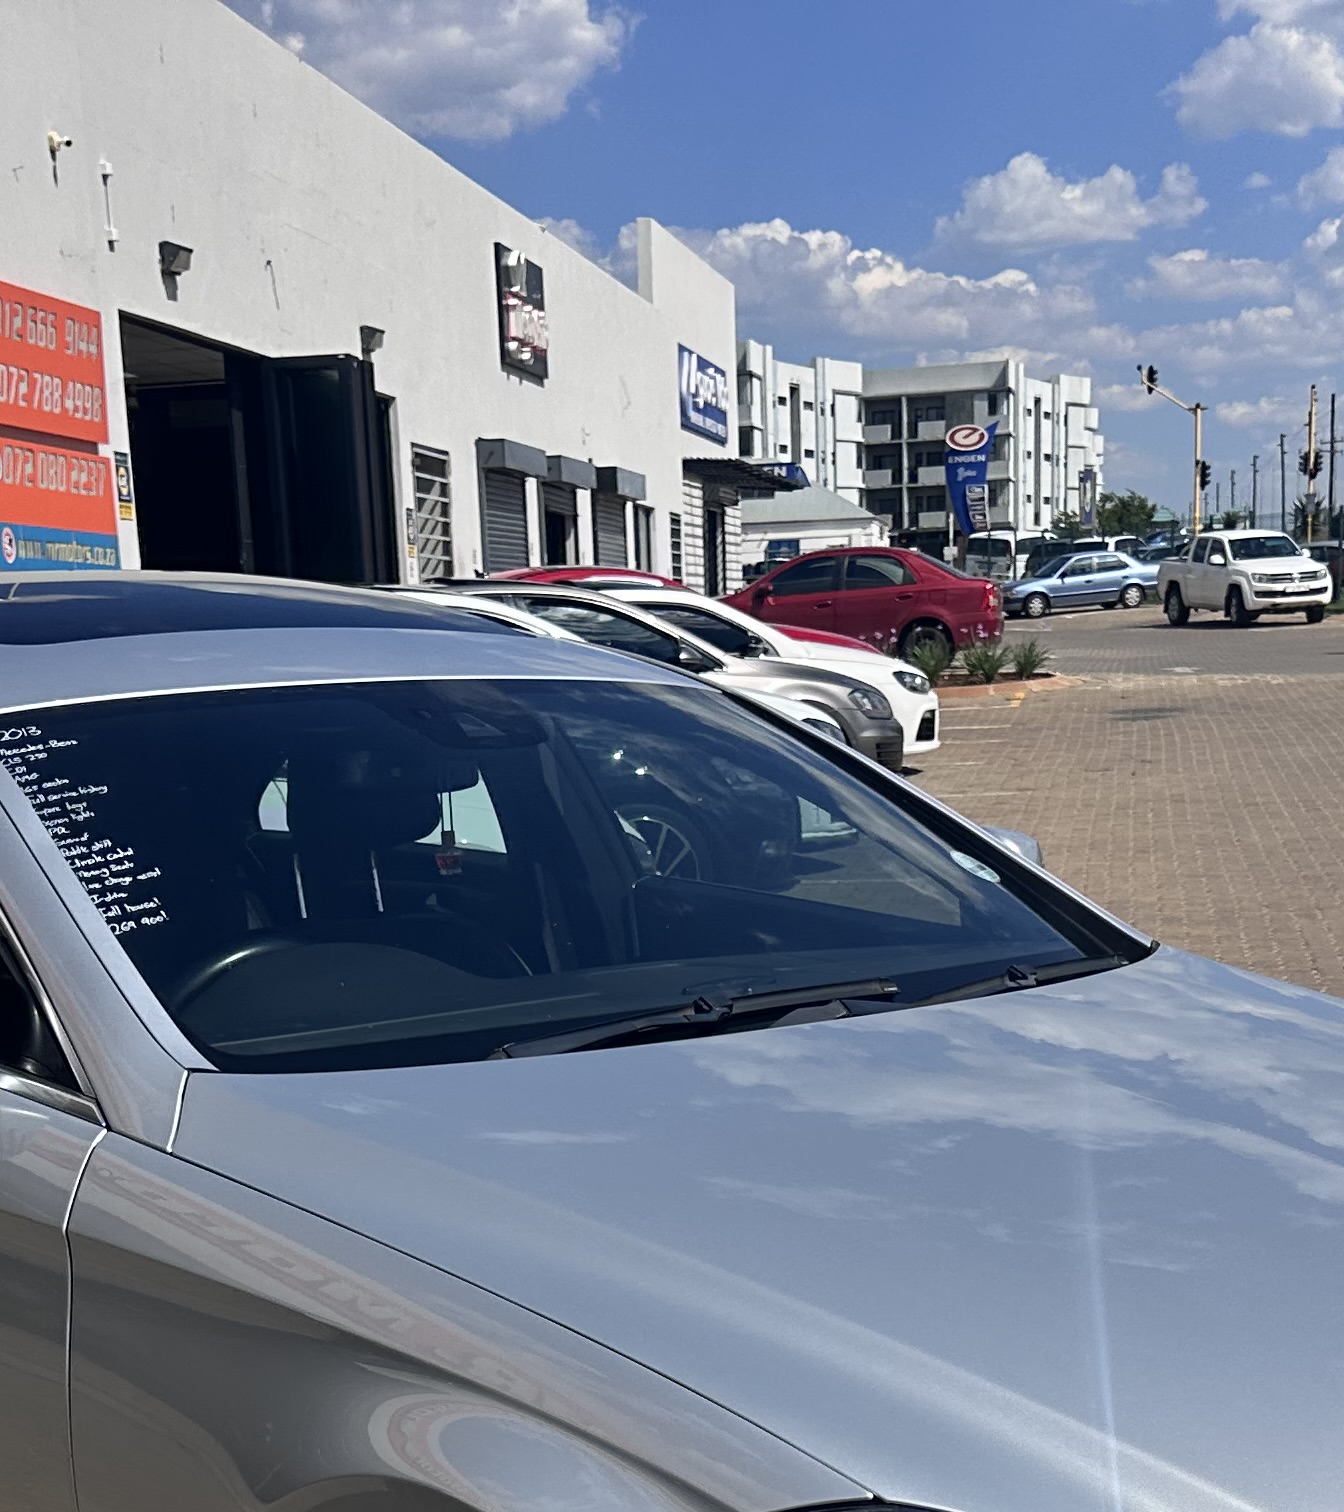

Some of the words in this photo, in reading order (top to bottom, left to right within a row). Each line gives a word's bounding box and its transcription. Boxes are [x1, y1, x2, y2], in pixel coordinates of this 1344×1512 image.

[26, 305, 57, 352] 666
[64, 316, 98, 362] 9144
[32, 370, 63, 414] 788
[63, 380, 103, 423] 4998
[1, 444, 35, 488] 072
[37, 450, 67, 493] 080
[69, 456, 106, 498] 2237
[140, 910, 169, 926] 900!
